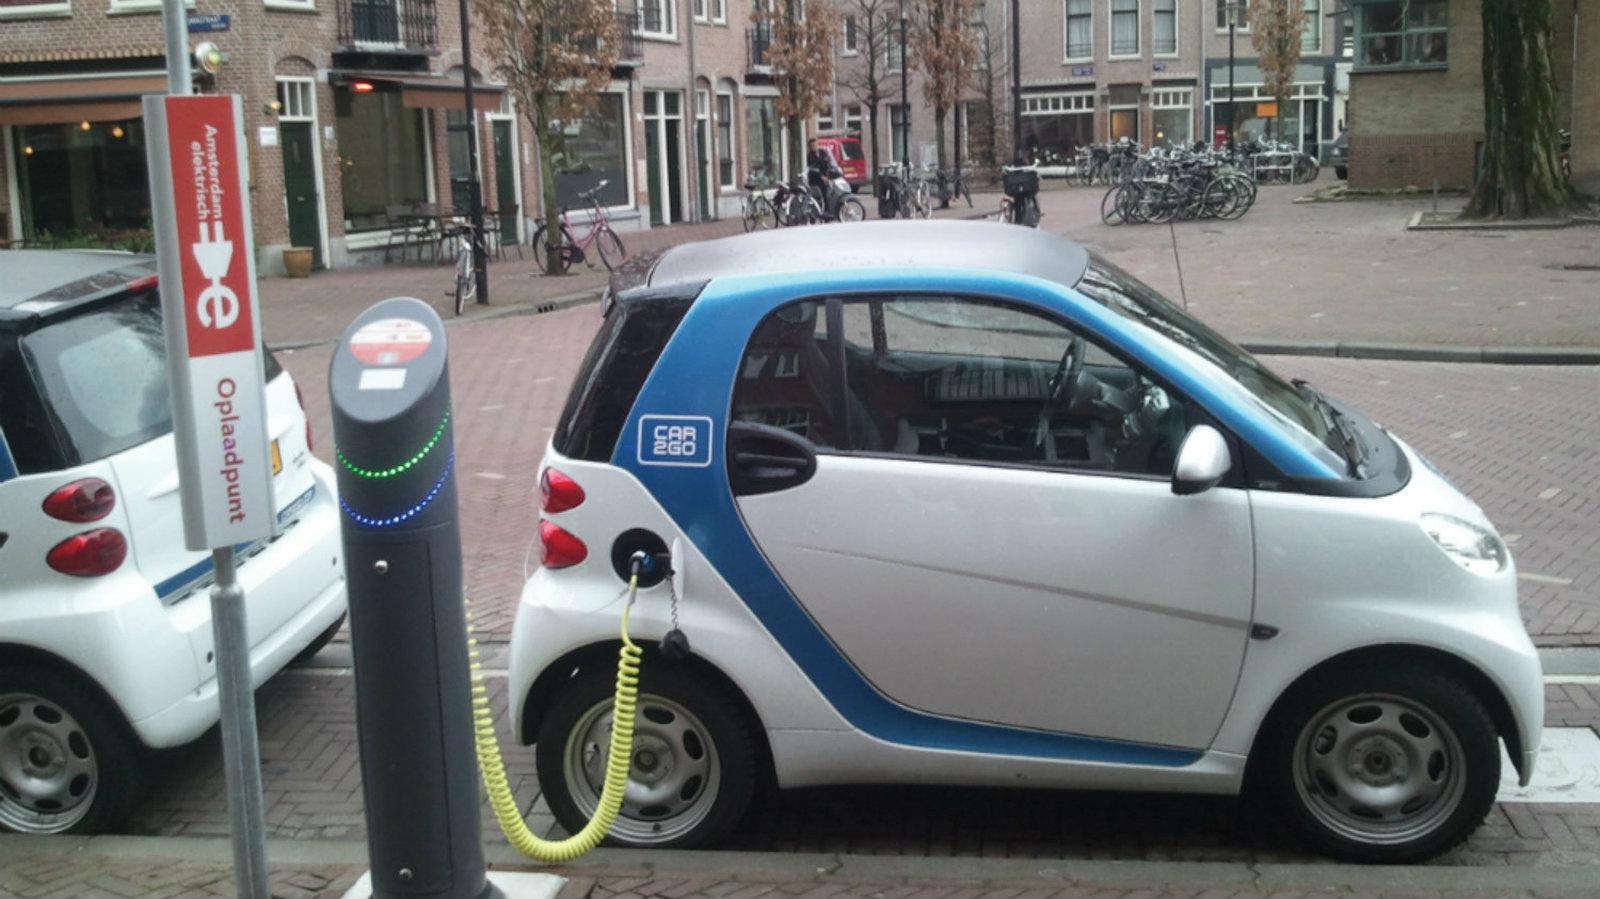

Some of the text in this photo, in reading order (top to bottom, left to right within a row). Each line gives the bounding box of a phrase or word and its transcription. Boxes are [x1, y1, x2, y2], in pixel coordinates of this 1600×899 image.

[190, 140, 211, 220] elektrisch
[204, 124, 225, 219] Amsterdam
[214, 377, 247, 525] Oplaadpunt
[653, 440, 696, 456] 2GO
[654, 425, 697, 441] CAR
